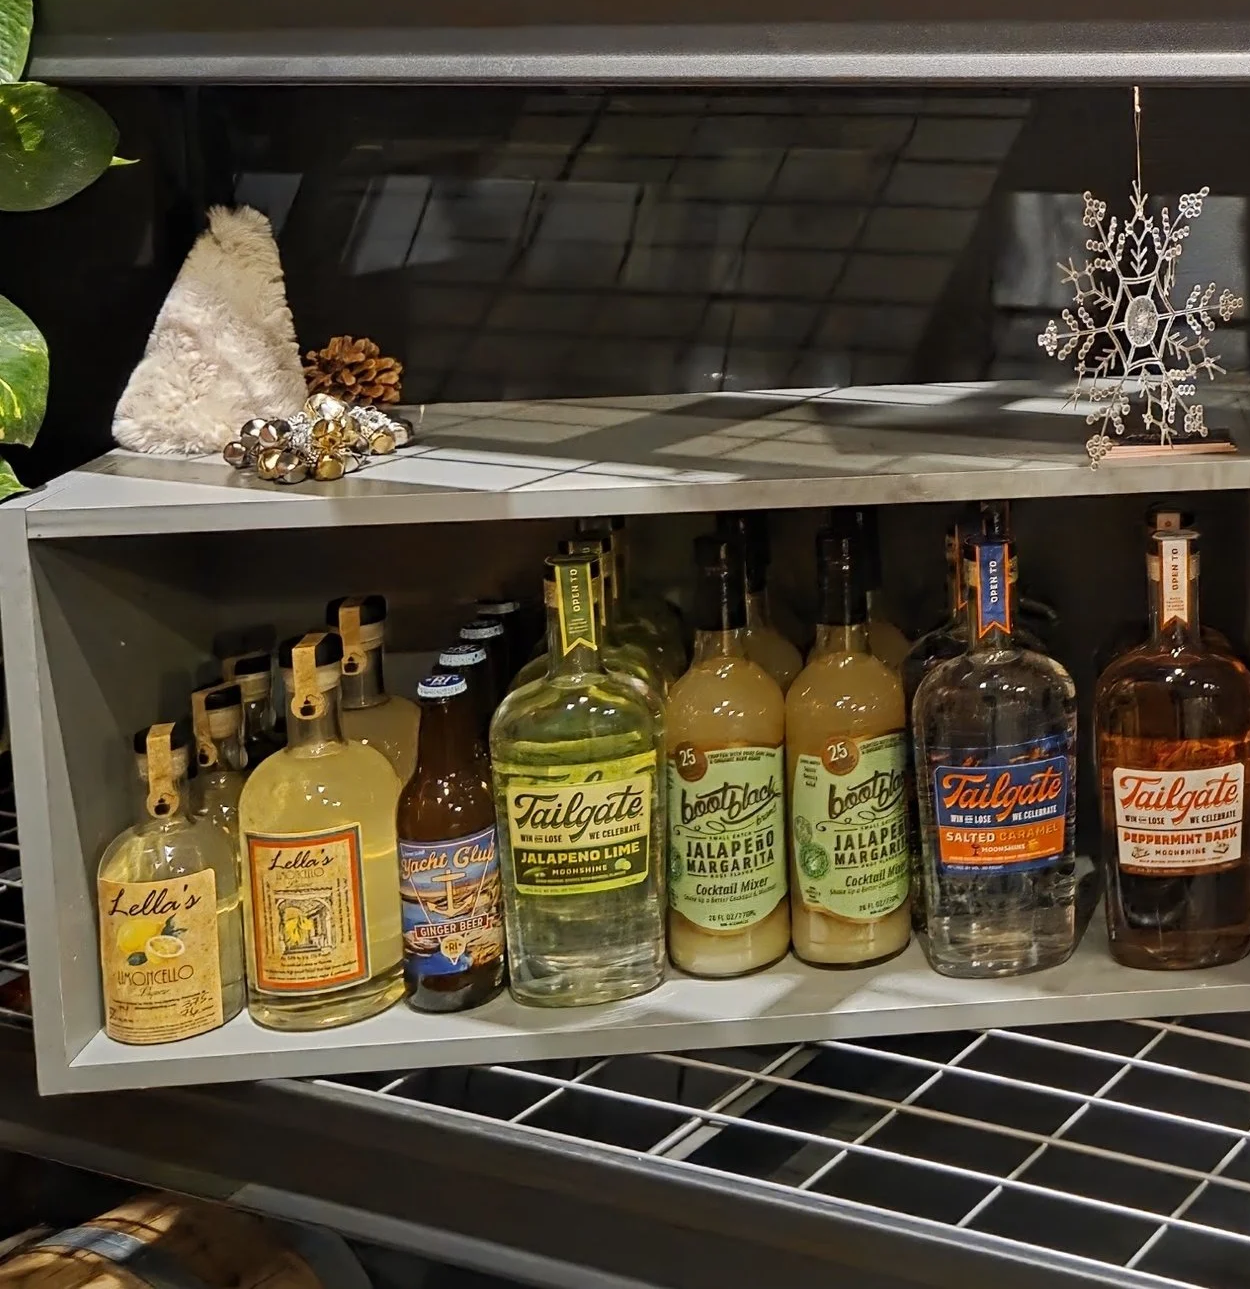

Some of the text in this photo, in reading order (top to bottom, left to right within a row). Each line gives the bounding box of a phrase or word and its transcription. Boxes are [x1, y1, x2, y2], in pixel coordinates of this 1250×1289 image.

[569, 568, 578, 583] TO
[1171, 548, 1179, 591] OPEN TO
[989, 560, 998, 603] OPEN TO
[571, 585, 581, 613] OPEN
[679, 748, 697, 767] 25
[827, 742, 849, 762] 25
[681, 775, 781, 825] bootblack
[943, 765, 1063, 822] Tailgate
[1119, 772, 1239, 826] Tailgate
[514, 785, 643, 843] Tailgate
[951, 804, 1058, 824] WIN LOSE WE CELEBRATE
[1148, 817, 1165, 825] LOSE
[1190, 816, 1200, 824] WE
[1201, 810, 1236, 823] CELEBRATE
[520, 834, 533, 842] WIN
[545, 835, 562, 843] LOSE
[589, 832, 600, 840] WE
[602, 823, 641, 838] CELEBRATE
[946, 822, 1058, 843] SALTED CARAMEL
[1123, 827, 1238, 845] PEPPERMINT BARK
[521, 841, 640, 864] JALAPENO LIME
[981, 843, 1026, 853] MOONSHINE
[1155, 847, 1206, 856] MOONSHINE
[268, 848, 335, 871] Lella's
[402, 851, 449, 880] Yacht
[686, 850, 775, 873] MARGARITA
[552, 864, 608, 876] MOONSHINE
[845, 869, 886, 887] Cocktail
[696, 882, 738, 896] Cocktail
[741, 877, 769, 892] Mixer
[109, 884, 202, 916] Lella's
[420, 917, 483, 937] GINGER BEER
[449, 941, 458, 951] RI
[117, 964, 194, 987] LIMONCELLO
